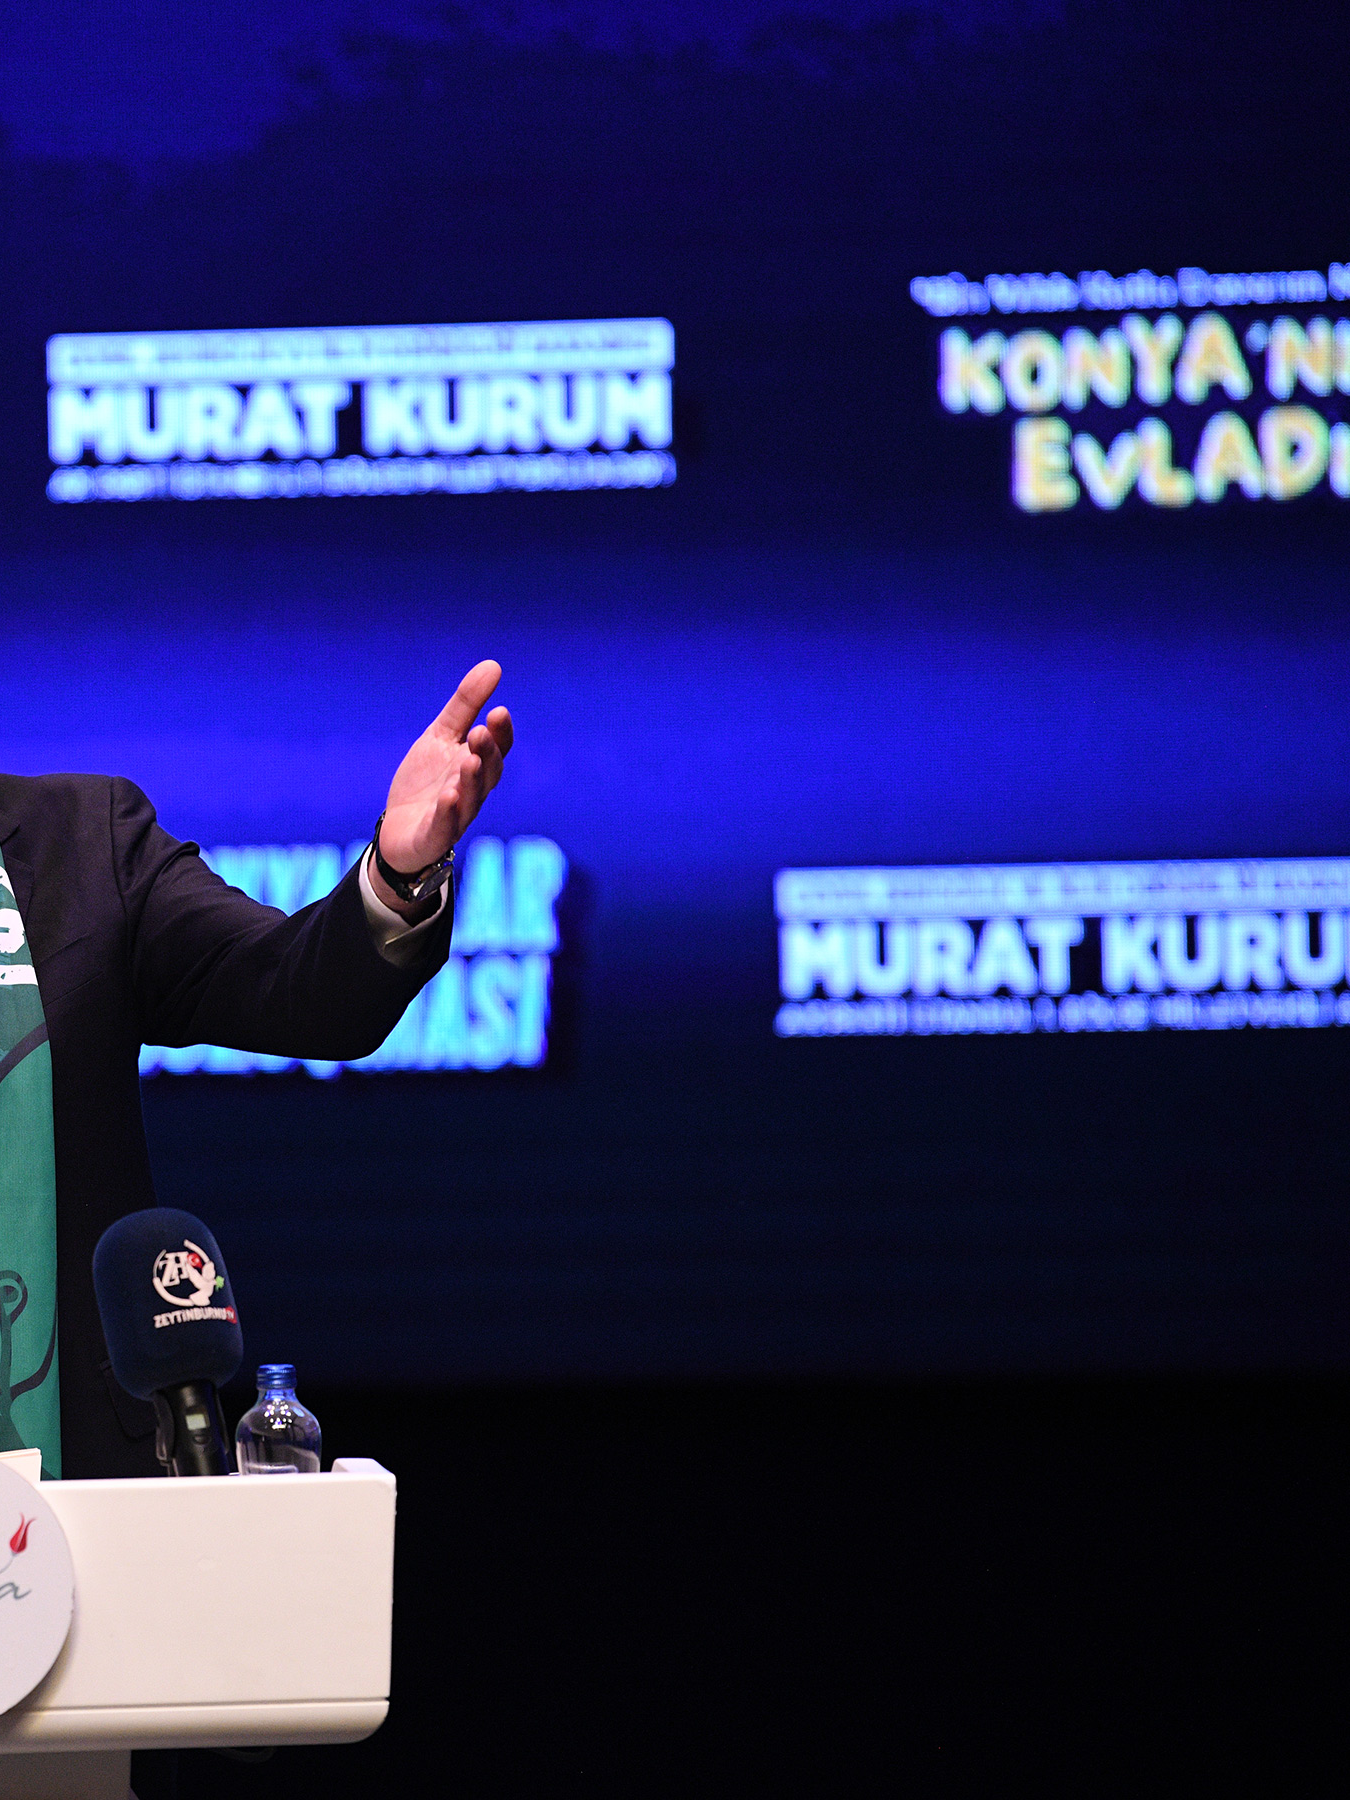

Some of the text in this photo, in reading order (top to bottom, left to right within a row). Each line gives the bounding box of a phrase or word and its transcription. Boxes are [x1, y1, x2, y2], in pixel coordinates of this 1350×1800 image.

[48, 370, 674, 464] MURAT KURUM
[779, 908, 1350, 1000] MURAT KURU
